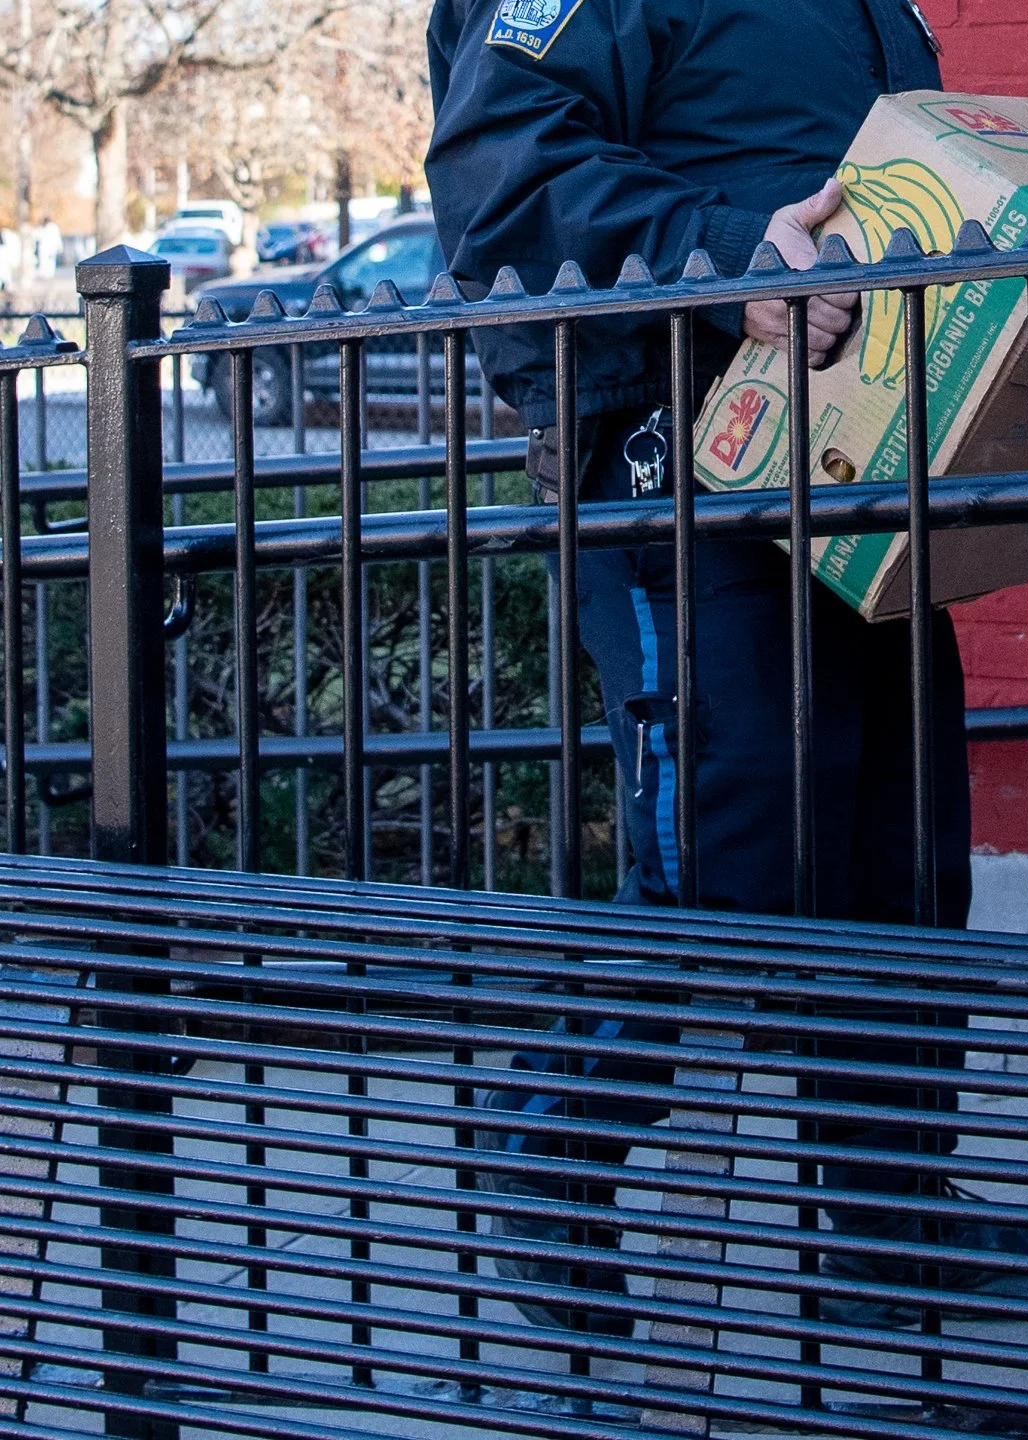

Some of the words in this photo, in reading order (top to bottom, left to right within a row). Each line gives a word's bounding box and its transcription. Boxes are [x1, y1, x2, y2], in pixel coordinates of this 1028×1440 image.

[516, 31, 542, 49] 1630
[945, 108, 1022, 134] Dole
[984, 194, 1007, 228] 1100-01
[709, 388, 764, 468] Dole
